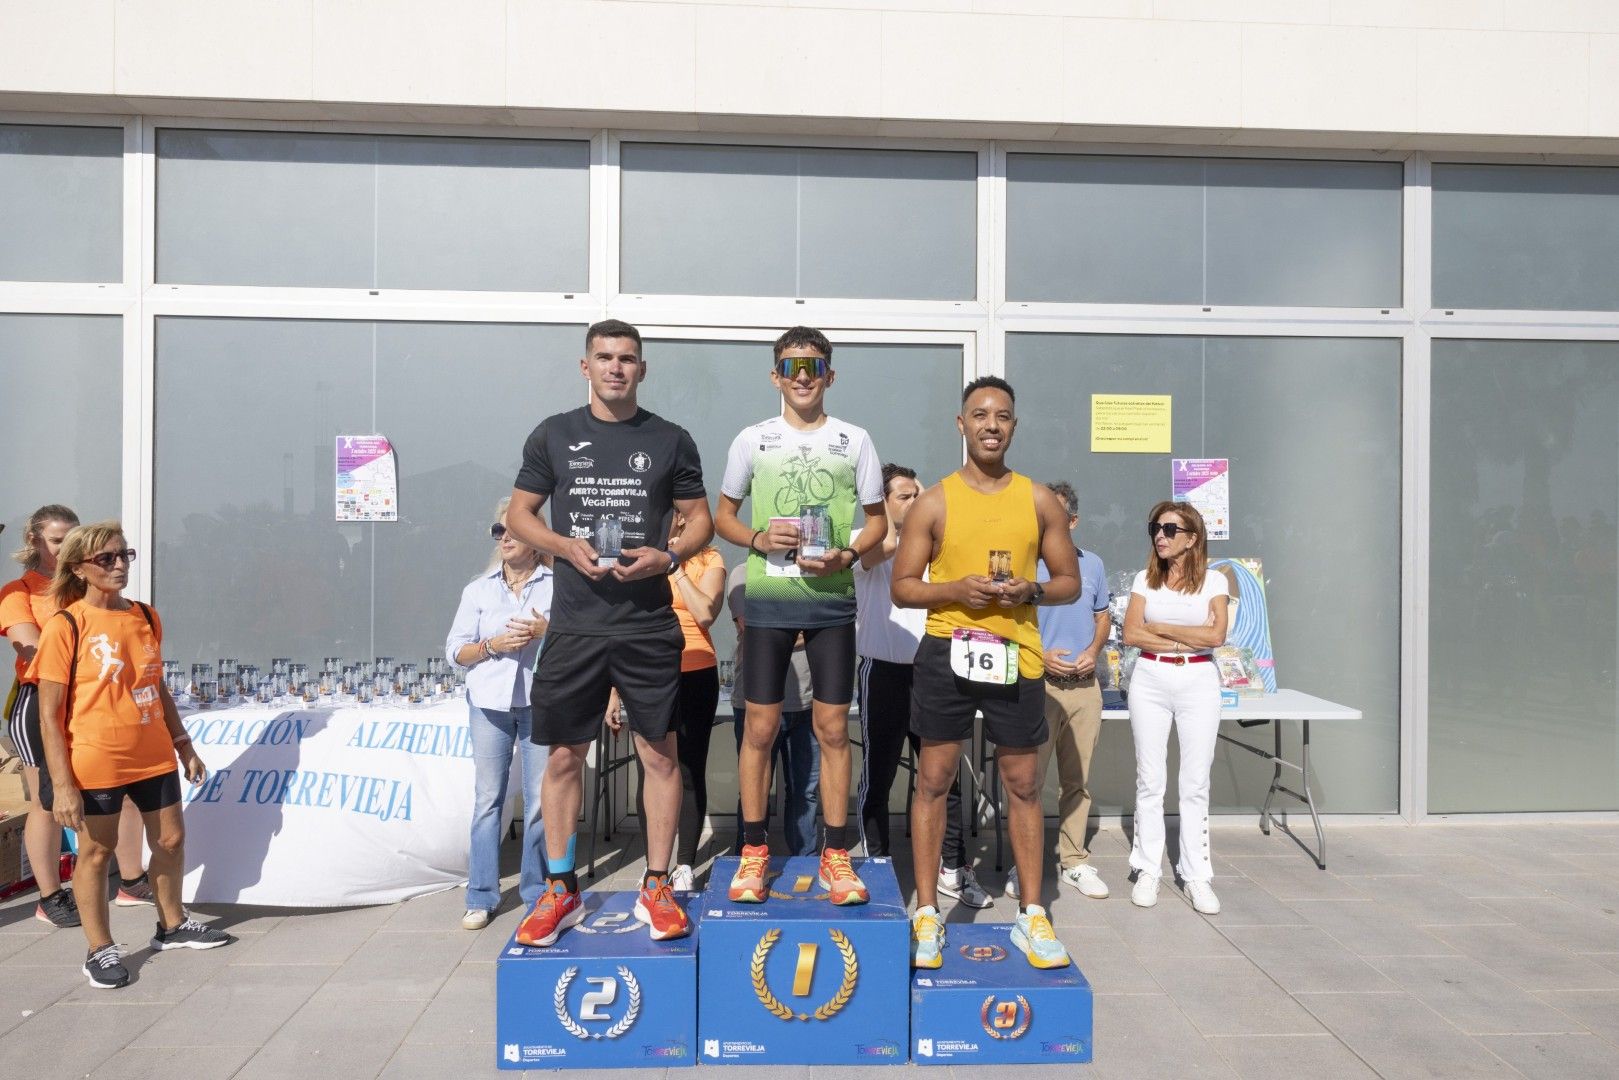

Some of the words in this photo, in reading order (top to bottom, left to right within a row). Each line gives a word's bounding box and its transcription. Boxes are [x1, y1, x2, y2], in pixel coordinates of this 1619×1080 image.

[600, 488, 647, 497] TORREVIEJA
[964, 651, 993, 670] 16
[238, 769, 413, 822] TORREVIEJA
[580, 976, 617, 1020] 2
[994, 1001, 1017, 1028] 3
